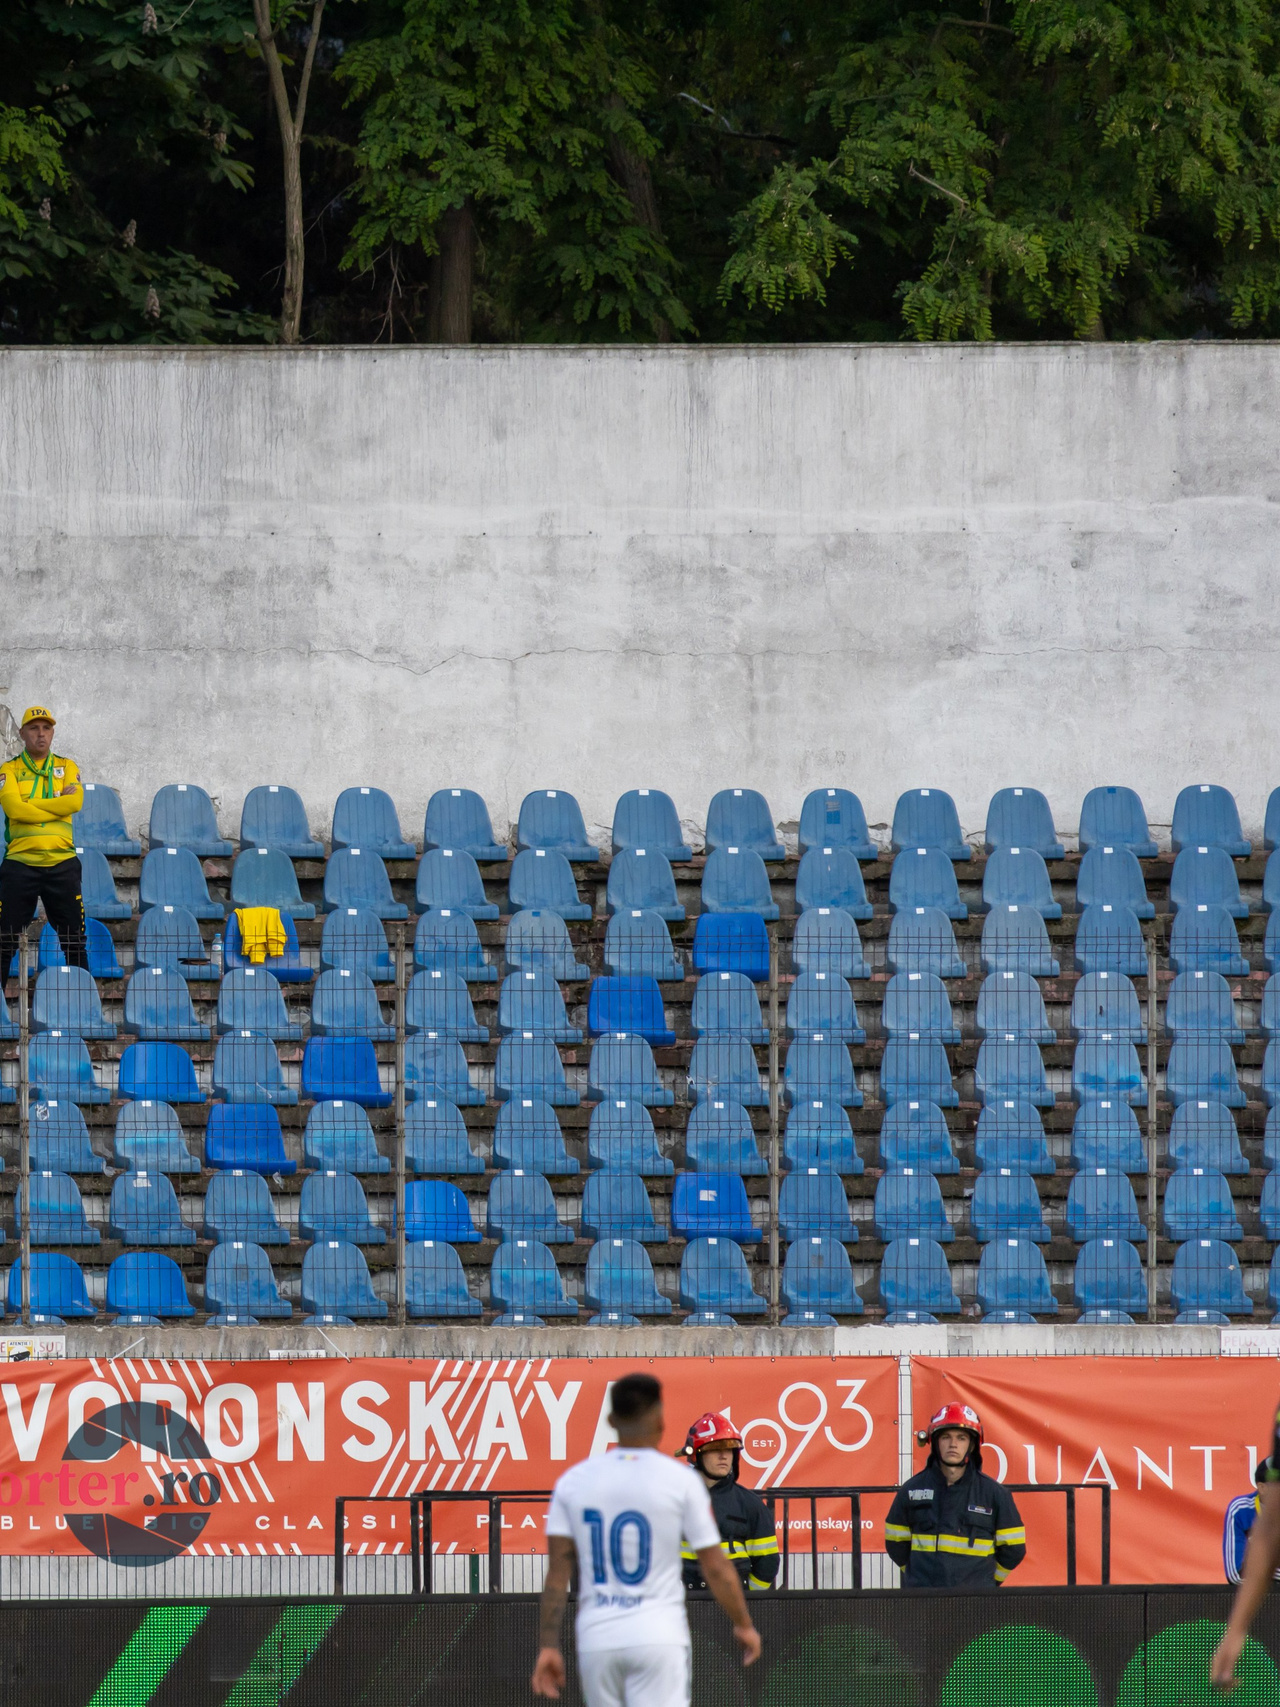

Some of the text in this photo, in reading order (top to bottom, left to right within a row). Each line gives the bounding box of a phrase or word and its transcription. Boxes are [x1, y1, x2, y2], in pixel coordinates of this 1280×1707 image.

[39, 1341, 63, 1353] SUD
[752, 1439, 777, 1448] EST.
[1, 1515, 94, 1530] BLUE
[144, 1514, 205, 1530] BIO
[583, 1507, 652, 1586] 10
